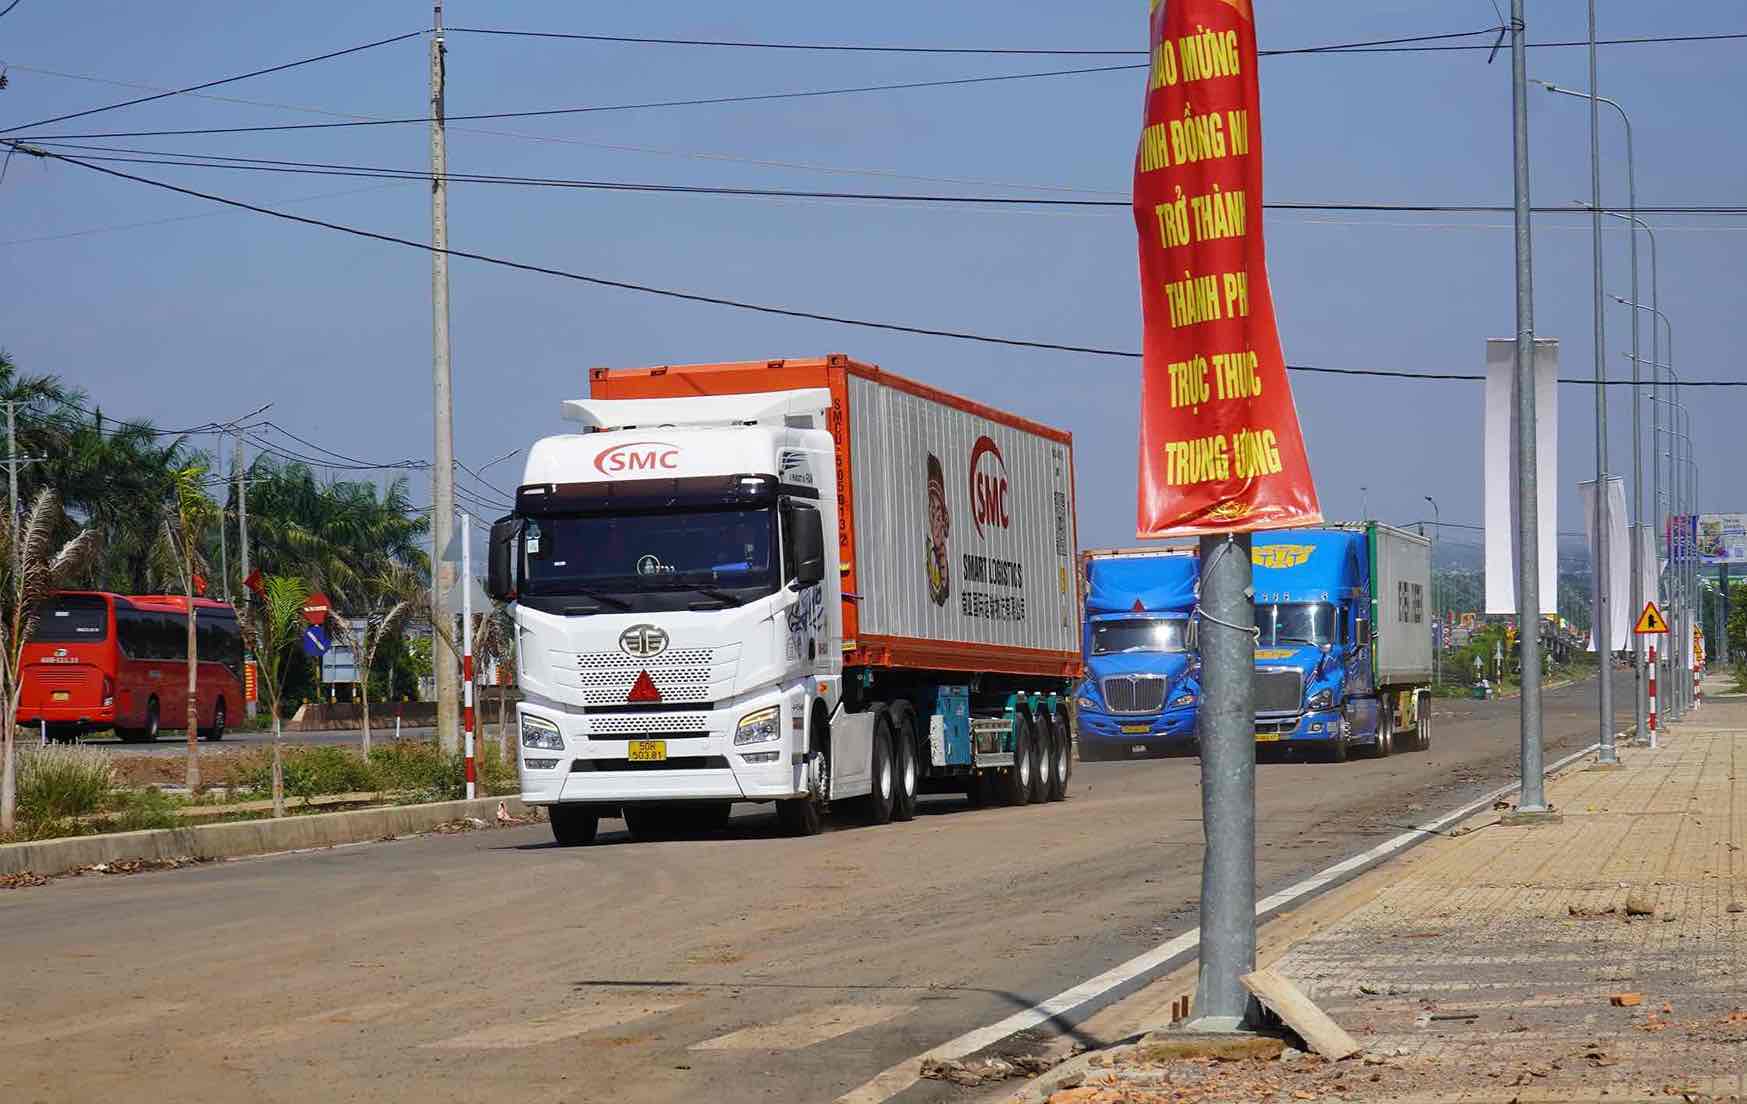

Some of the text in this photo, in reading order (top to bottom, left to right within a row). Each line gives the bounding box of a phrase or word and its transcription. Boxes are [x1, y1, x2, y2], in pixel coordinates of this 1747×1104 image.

[1179, 25, 1240, 82] MỪNG
[1170, 102, 1226, 165] ĐỒNG
[1155, 185, 1190, 249] TRỞ
[1165, 270, 1221, 328] THÀNH
[1168, 354, 1210, 415] TRỰC
[609, 450, 679, 471] SMC
[1166, 435, 1229, 485] TRUNG
[977, 471, 1009, 529] SMC
[963, 553, 987, 584] SMART
[988, 558, 1022, 589] LOGISTICS
